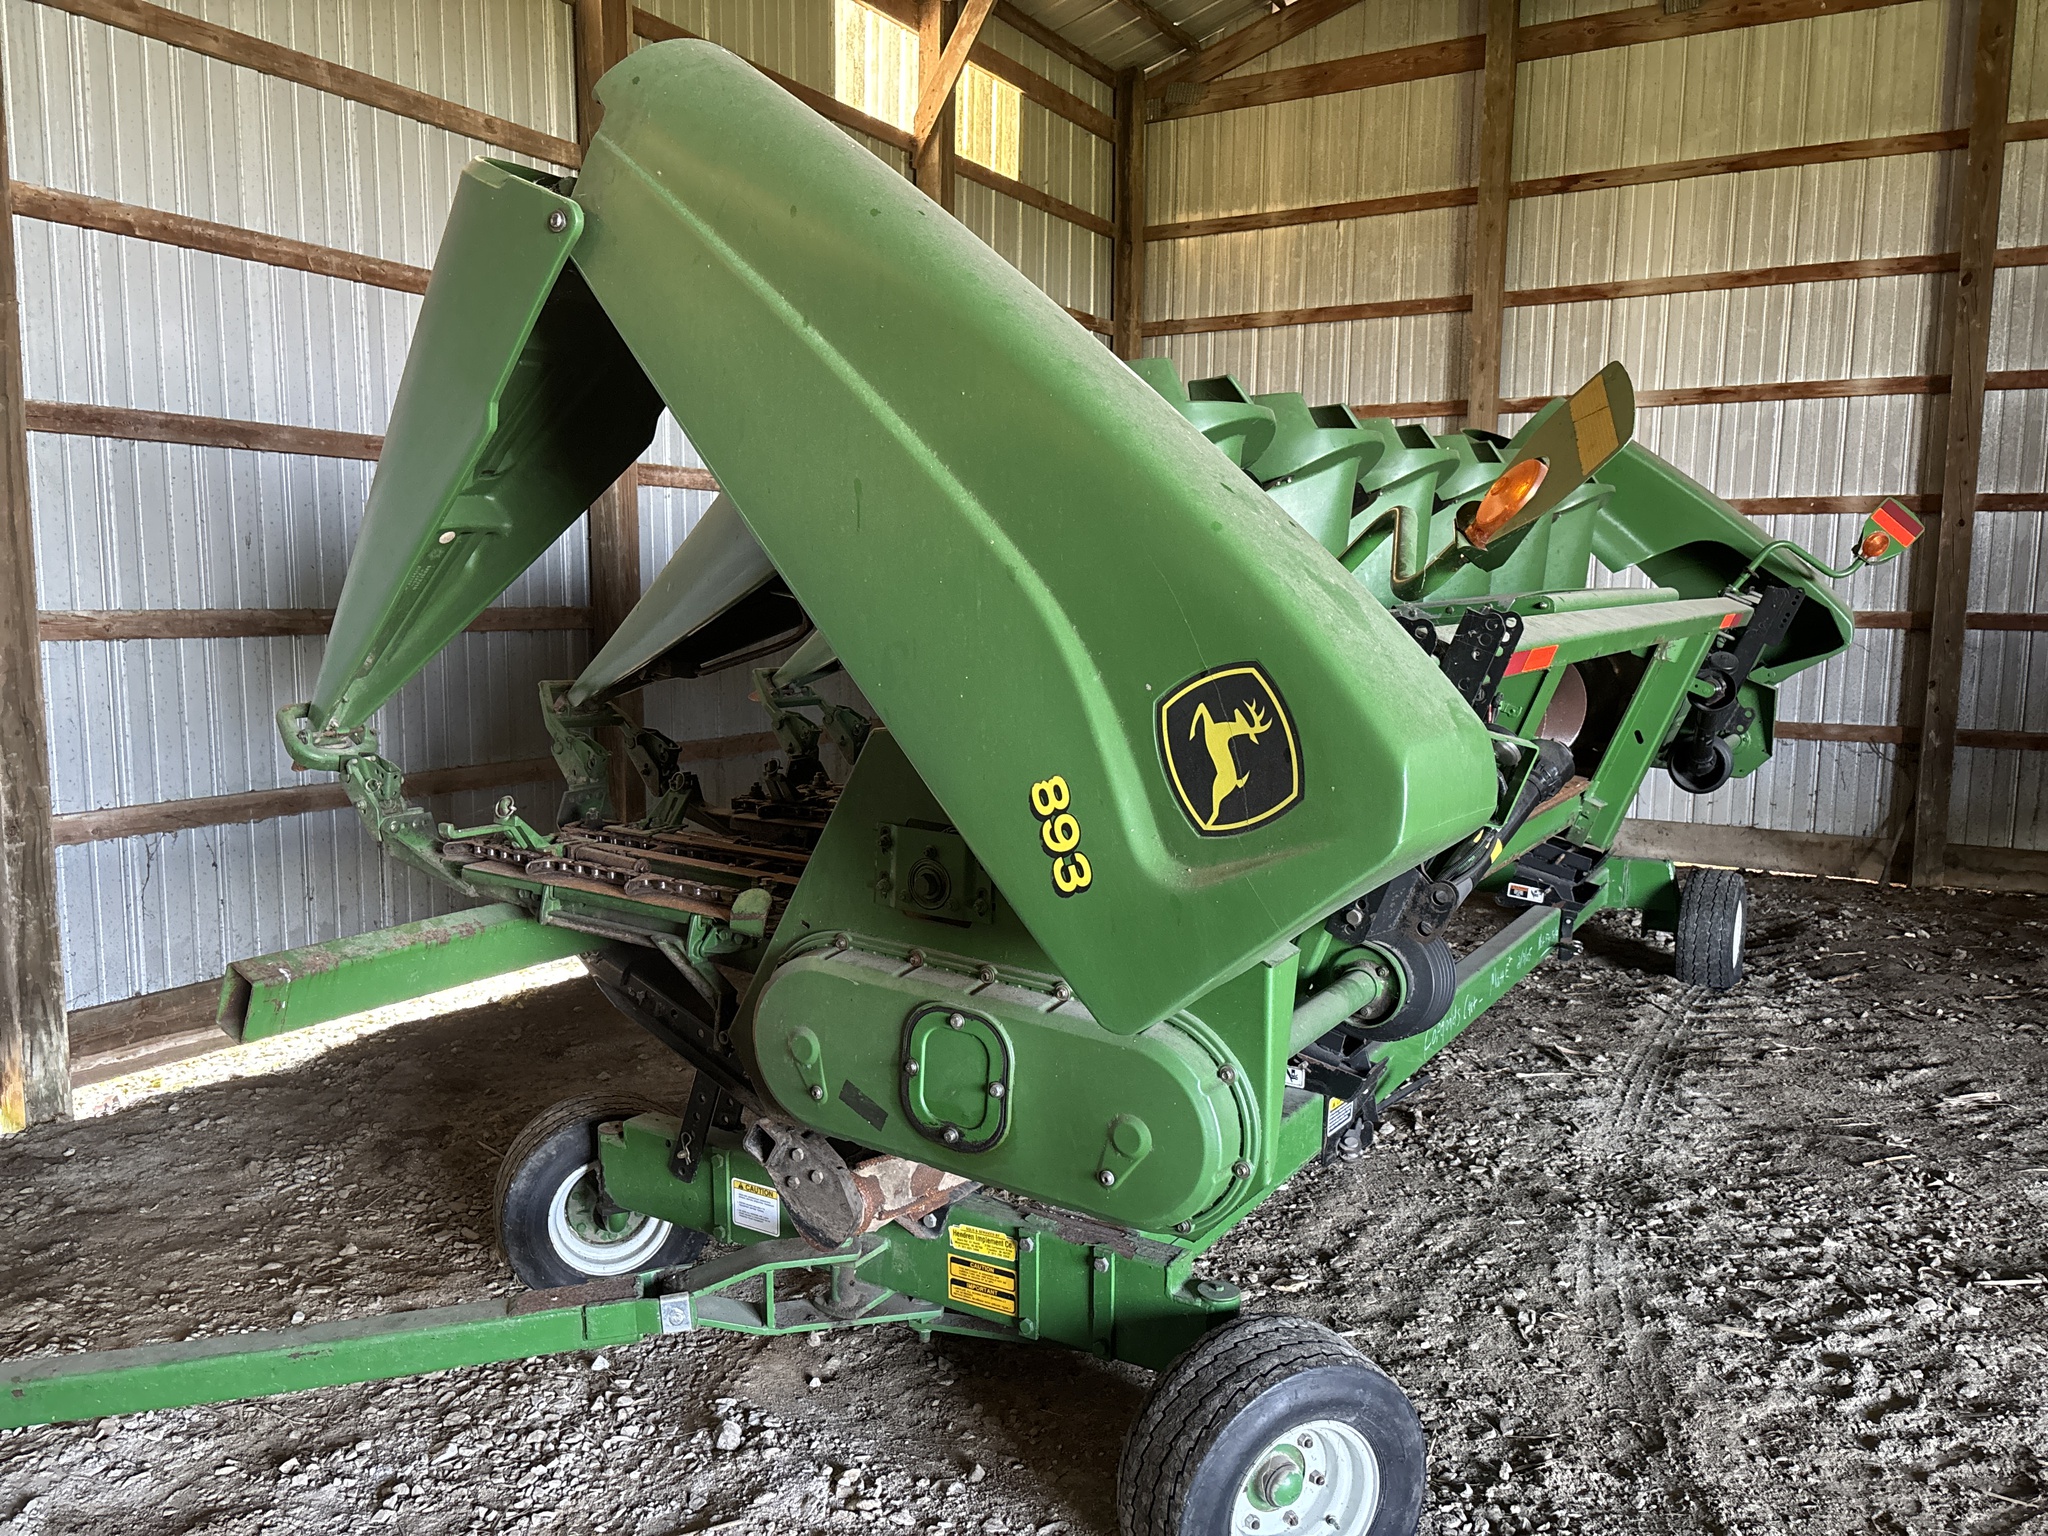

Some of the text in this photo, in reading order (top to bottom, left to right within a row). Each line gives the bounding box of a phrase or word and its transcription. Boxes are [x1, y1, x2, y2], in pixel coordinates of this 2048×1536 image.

[1029, 775, 1093, 898] 893
[745, 1184, 774, 1198] CAUTION
[952, 1229, 975, 1240] Hendren
[975, 1234, 1004, 1247] Implement
[969, 1262, 995, 1273] CAUTION
[966, 1282, 998, 1296] IMPORTANT
